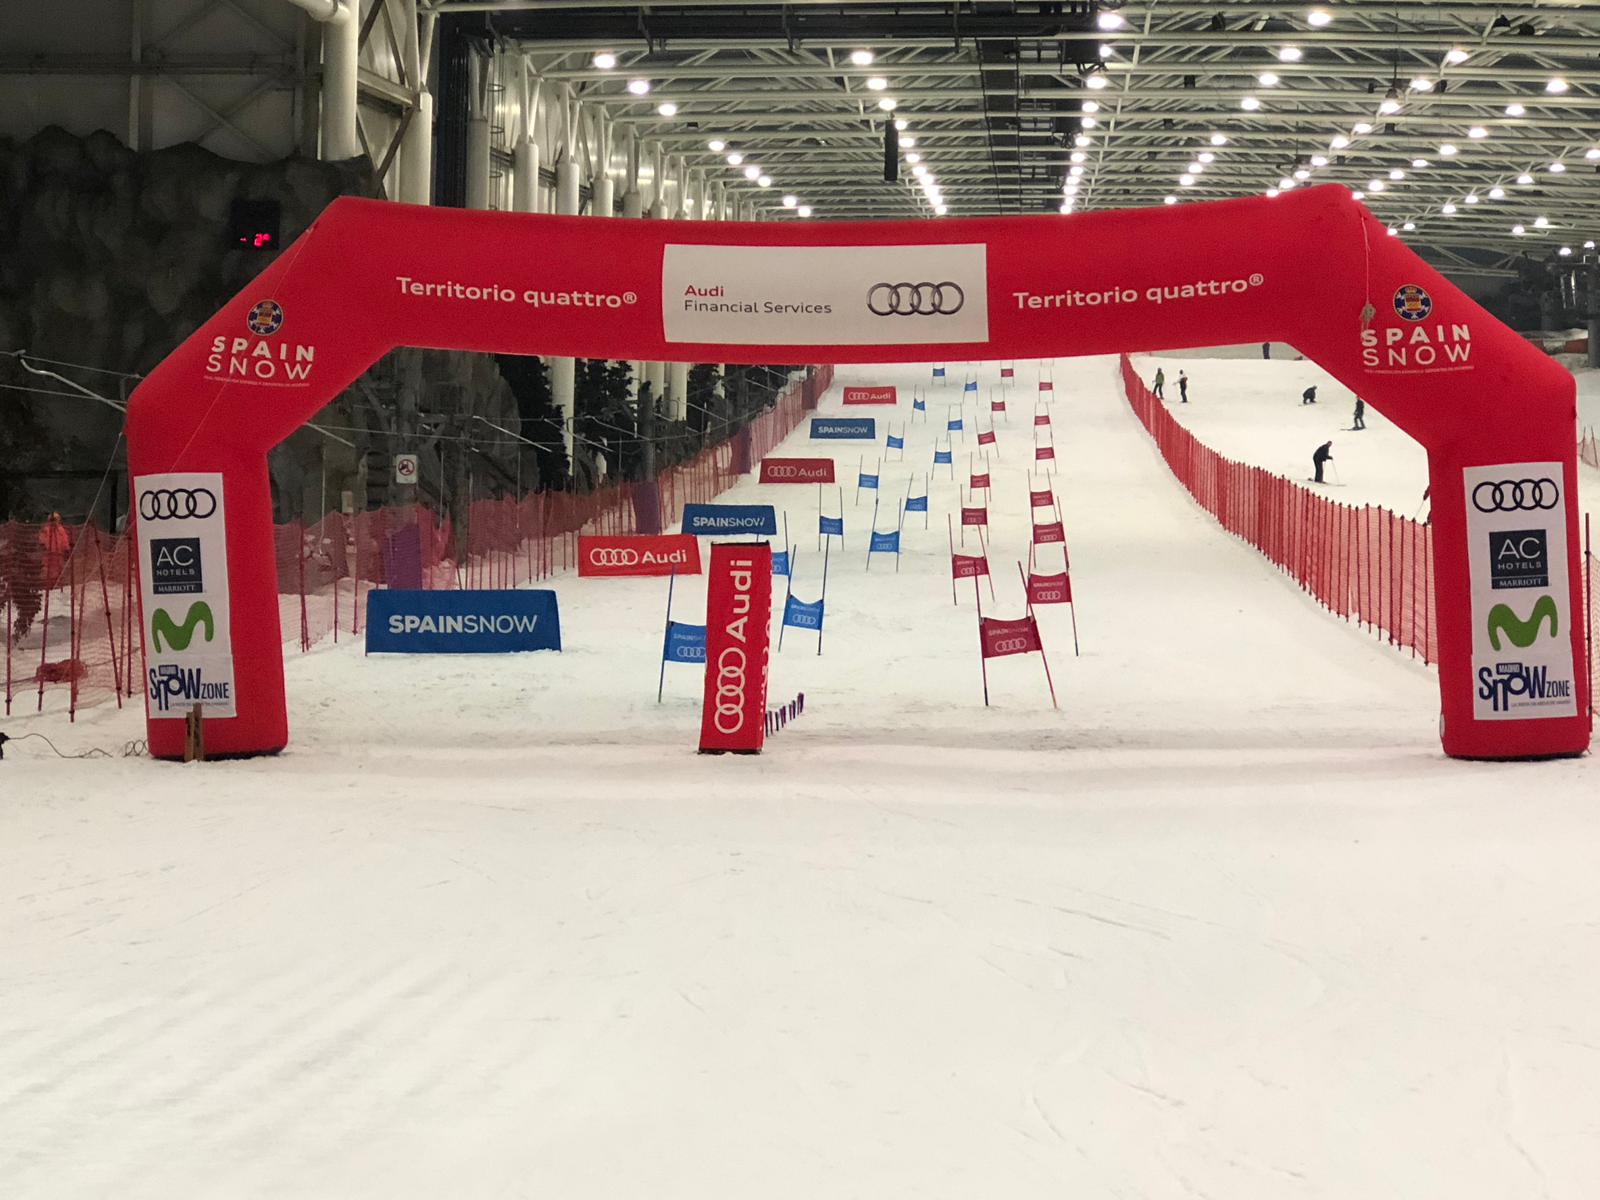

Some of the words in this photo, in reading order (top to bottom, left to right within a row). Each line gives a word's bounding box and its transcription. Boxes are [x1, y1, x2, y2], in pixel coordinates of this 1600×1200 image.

[396, 276, 516, 302] Territorio
[684, 284, 724, 297] Audi
[1012, 287, 1138, 309] Territorio
[684, 299, 759, 313] Financial
[763, 300, 832, 314] Services
[1361, 324, 1471, 347] SPAIN
[211, 335, 315, 362] SPAIN
[1362, 343, 1471, 366] SNOW
[206, 353, 313, 380] SNOW
[870, 392, 892, 400] Audi
[798, 468, 827, 477] Audi
[692, 516, 766, 527] SPAINSNOW
[156, 545, 194, 567] AC
[641, 549, 688, 564] Audi
[1498, 537, 1541, 560] AC
[1497, 561, 1542, 570] HOTELS
[1500, 578, 1542, 587] MARRIOTT
[726, 559, 753, 644] Audi
[388, 614, 538, 634] SPAINSNOW
